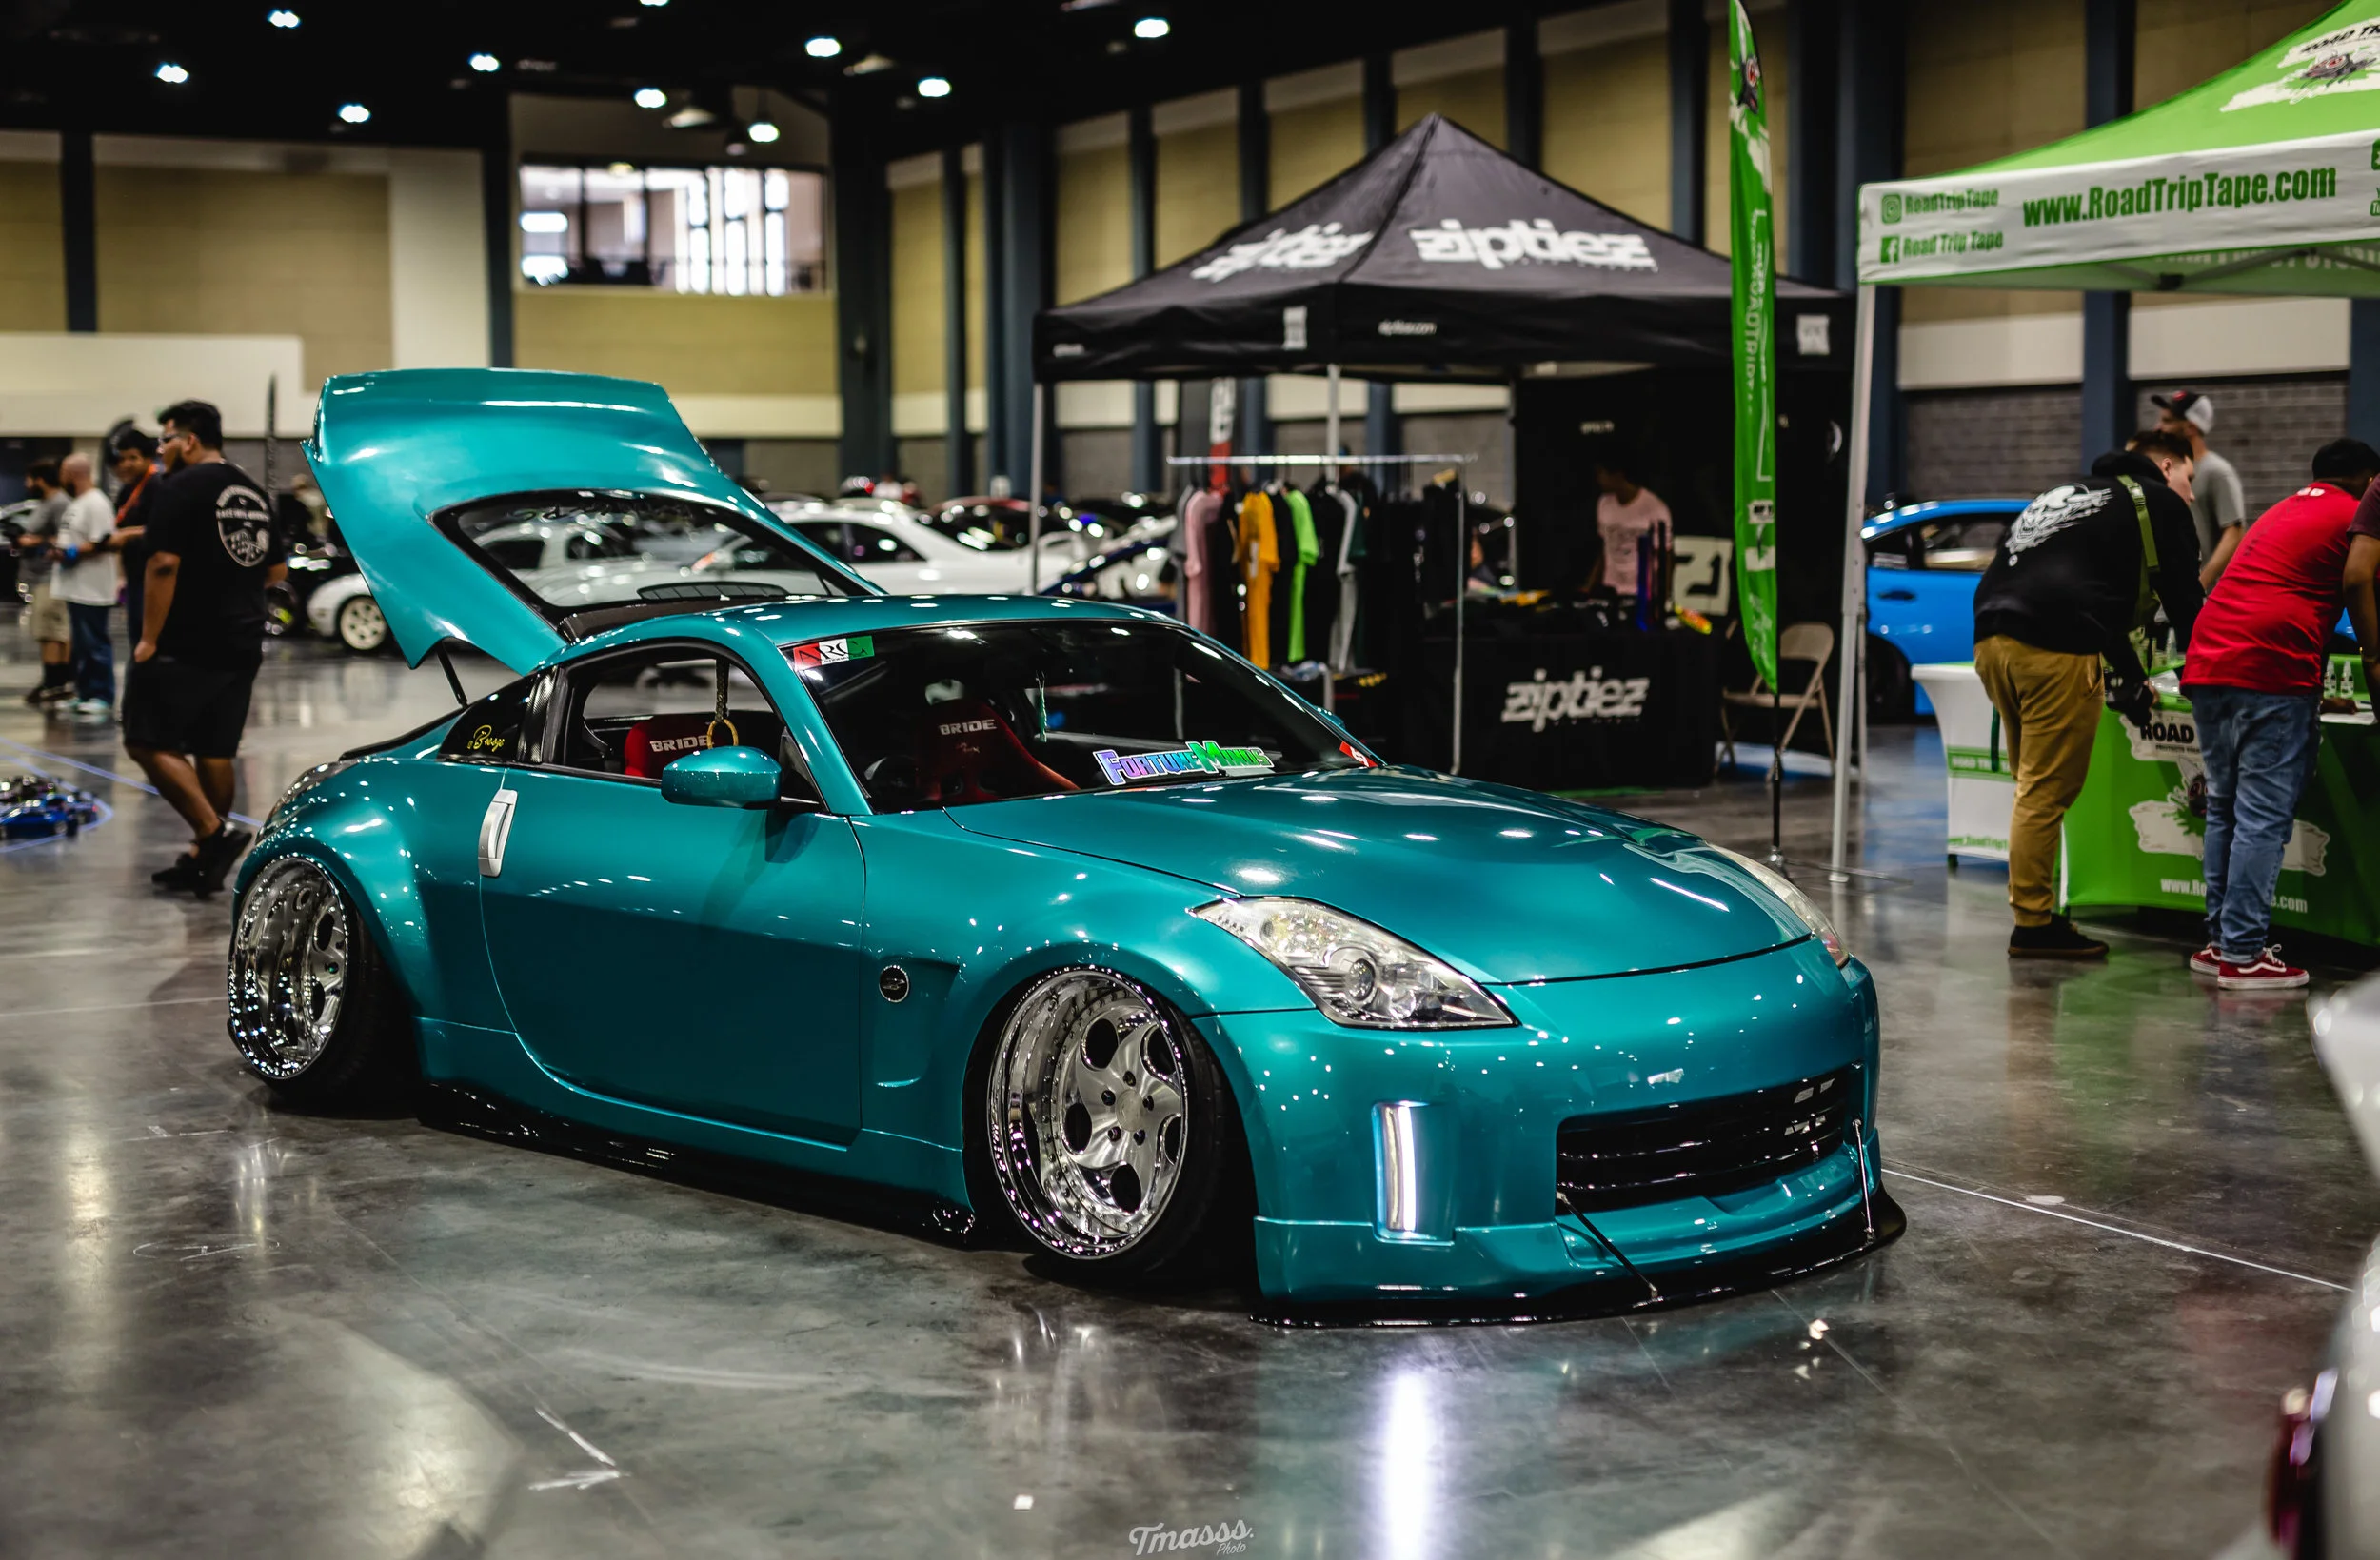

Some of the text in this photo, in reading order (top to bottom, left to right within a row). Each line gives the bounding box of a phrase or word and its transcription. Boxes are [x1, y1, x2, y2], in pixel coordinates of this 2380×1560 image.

[1905, 189, 1999, 214] RoadTripTape
[2022, 167, 2337, 227] www.RoadTripTape.com
[1409, 218, 1658, 271] ziptiez
[1903, 230, 2003, 258] Road Trip Tape
[1501, 665, 1650, 732] ziptiez
[939, 719, 998, 736] BRIDE
[2140, 722, 2195, 743] ROAD
[649, 735, 715, 753] BRIDE
